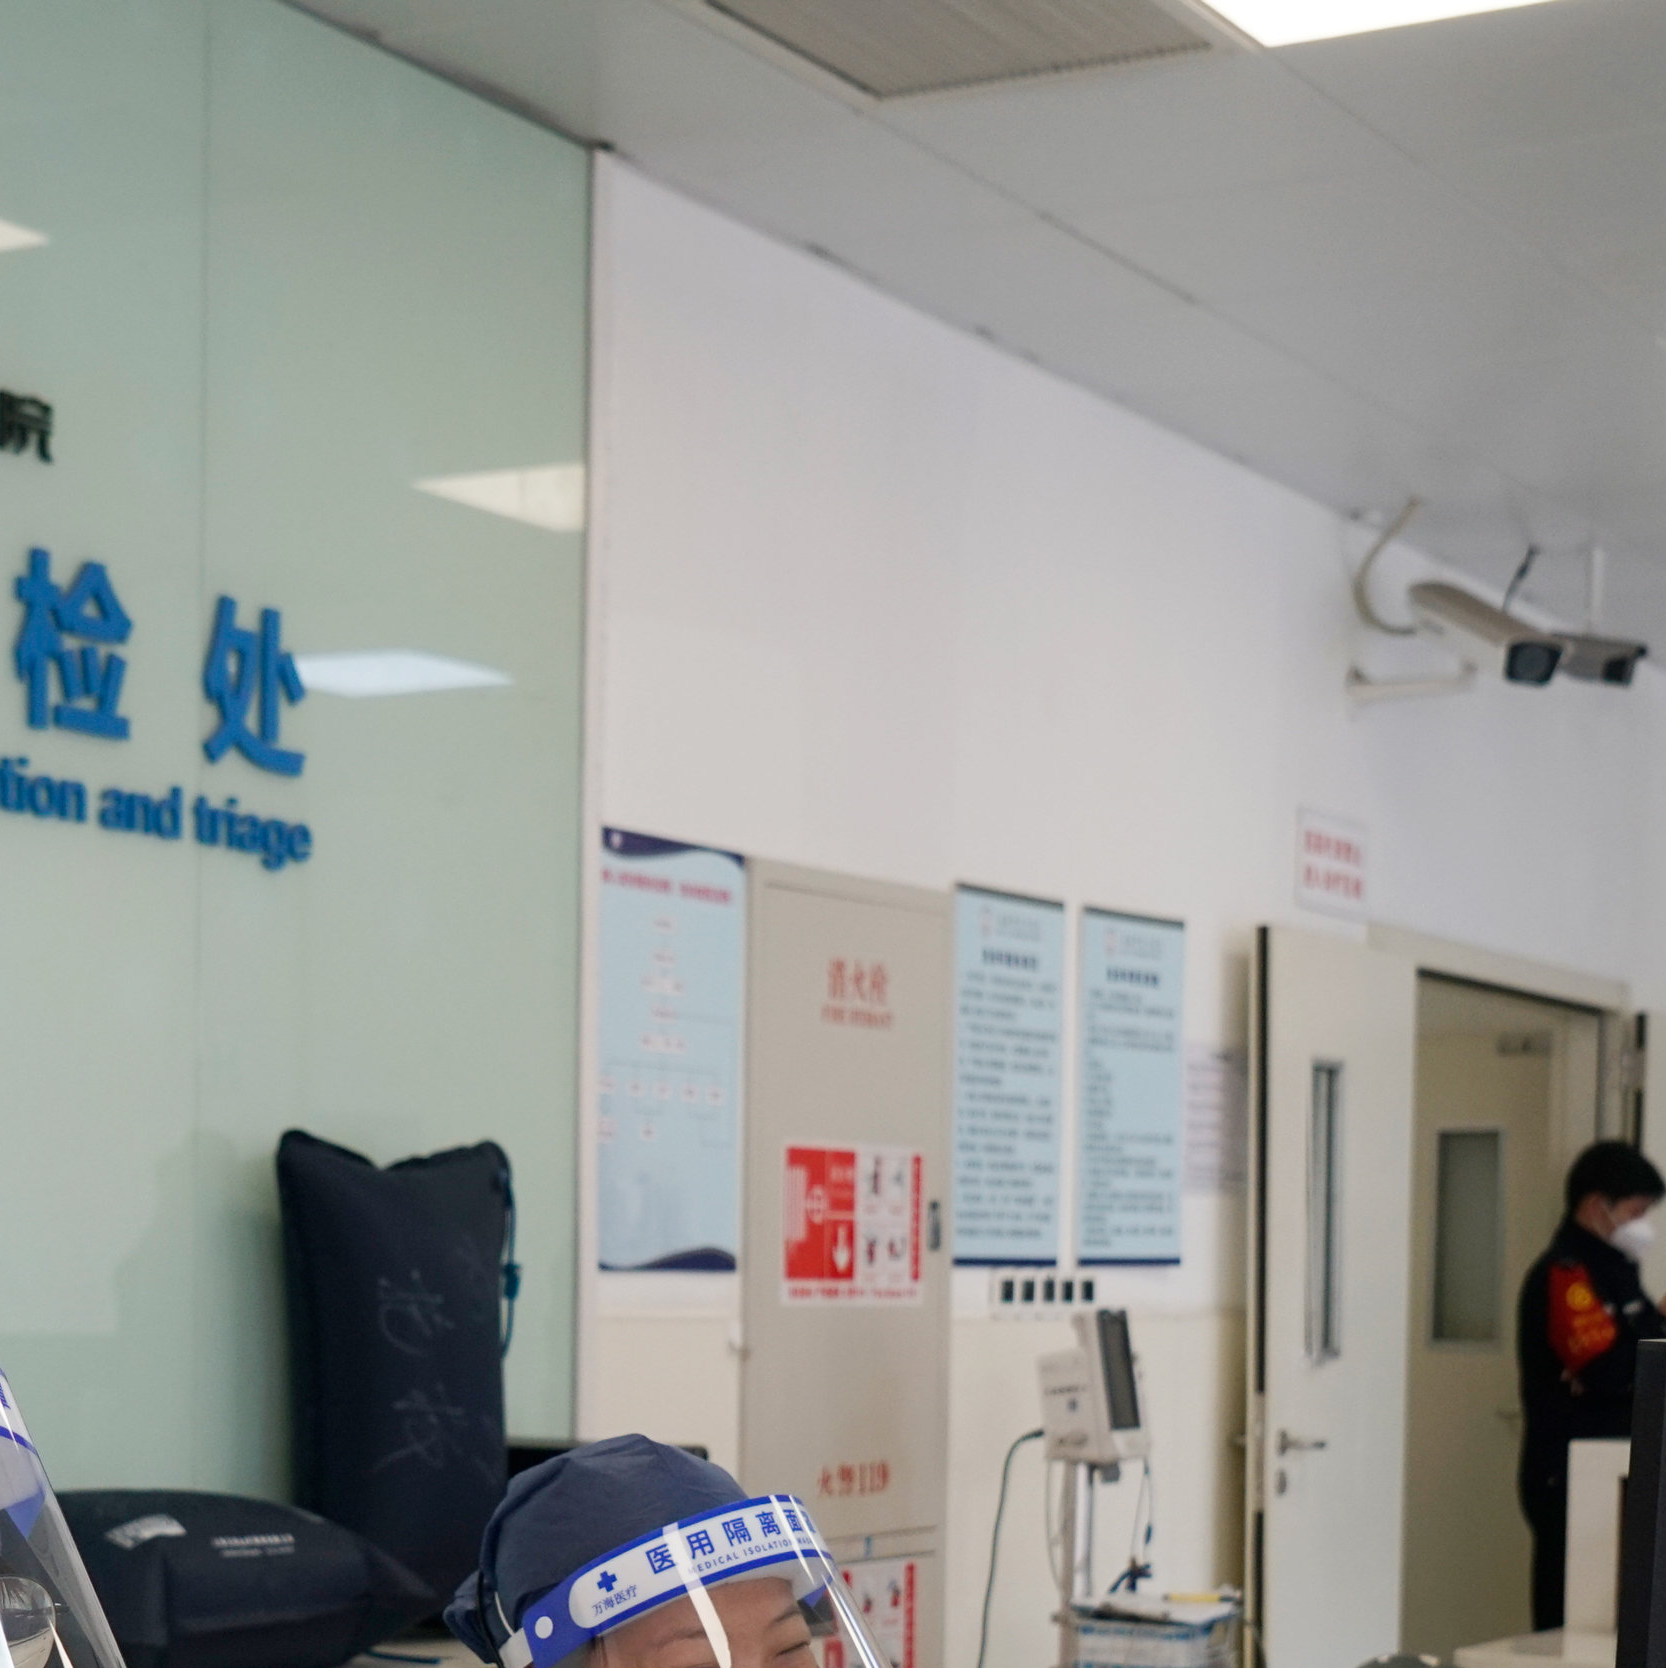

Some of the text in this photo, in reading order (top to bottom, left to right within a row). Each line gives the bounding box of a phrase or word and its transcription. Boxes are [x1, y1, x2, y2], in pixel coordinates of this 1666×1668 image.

[99, 786, 181, 841] and
[194, 794, 312, 872] triage
[592, 1584, 639, 1616] 万海医疗
